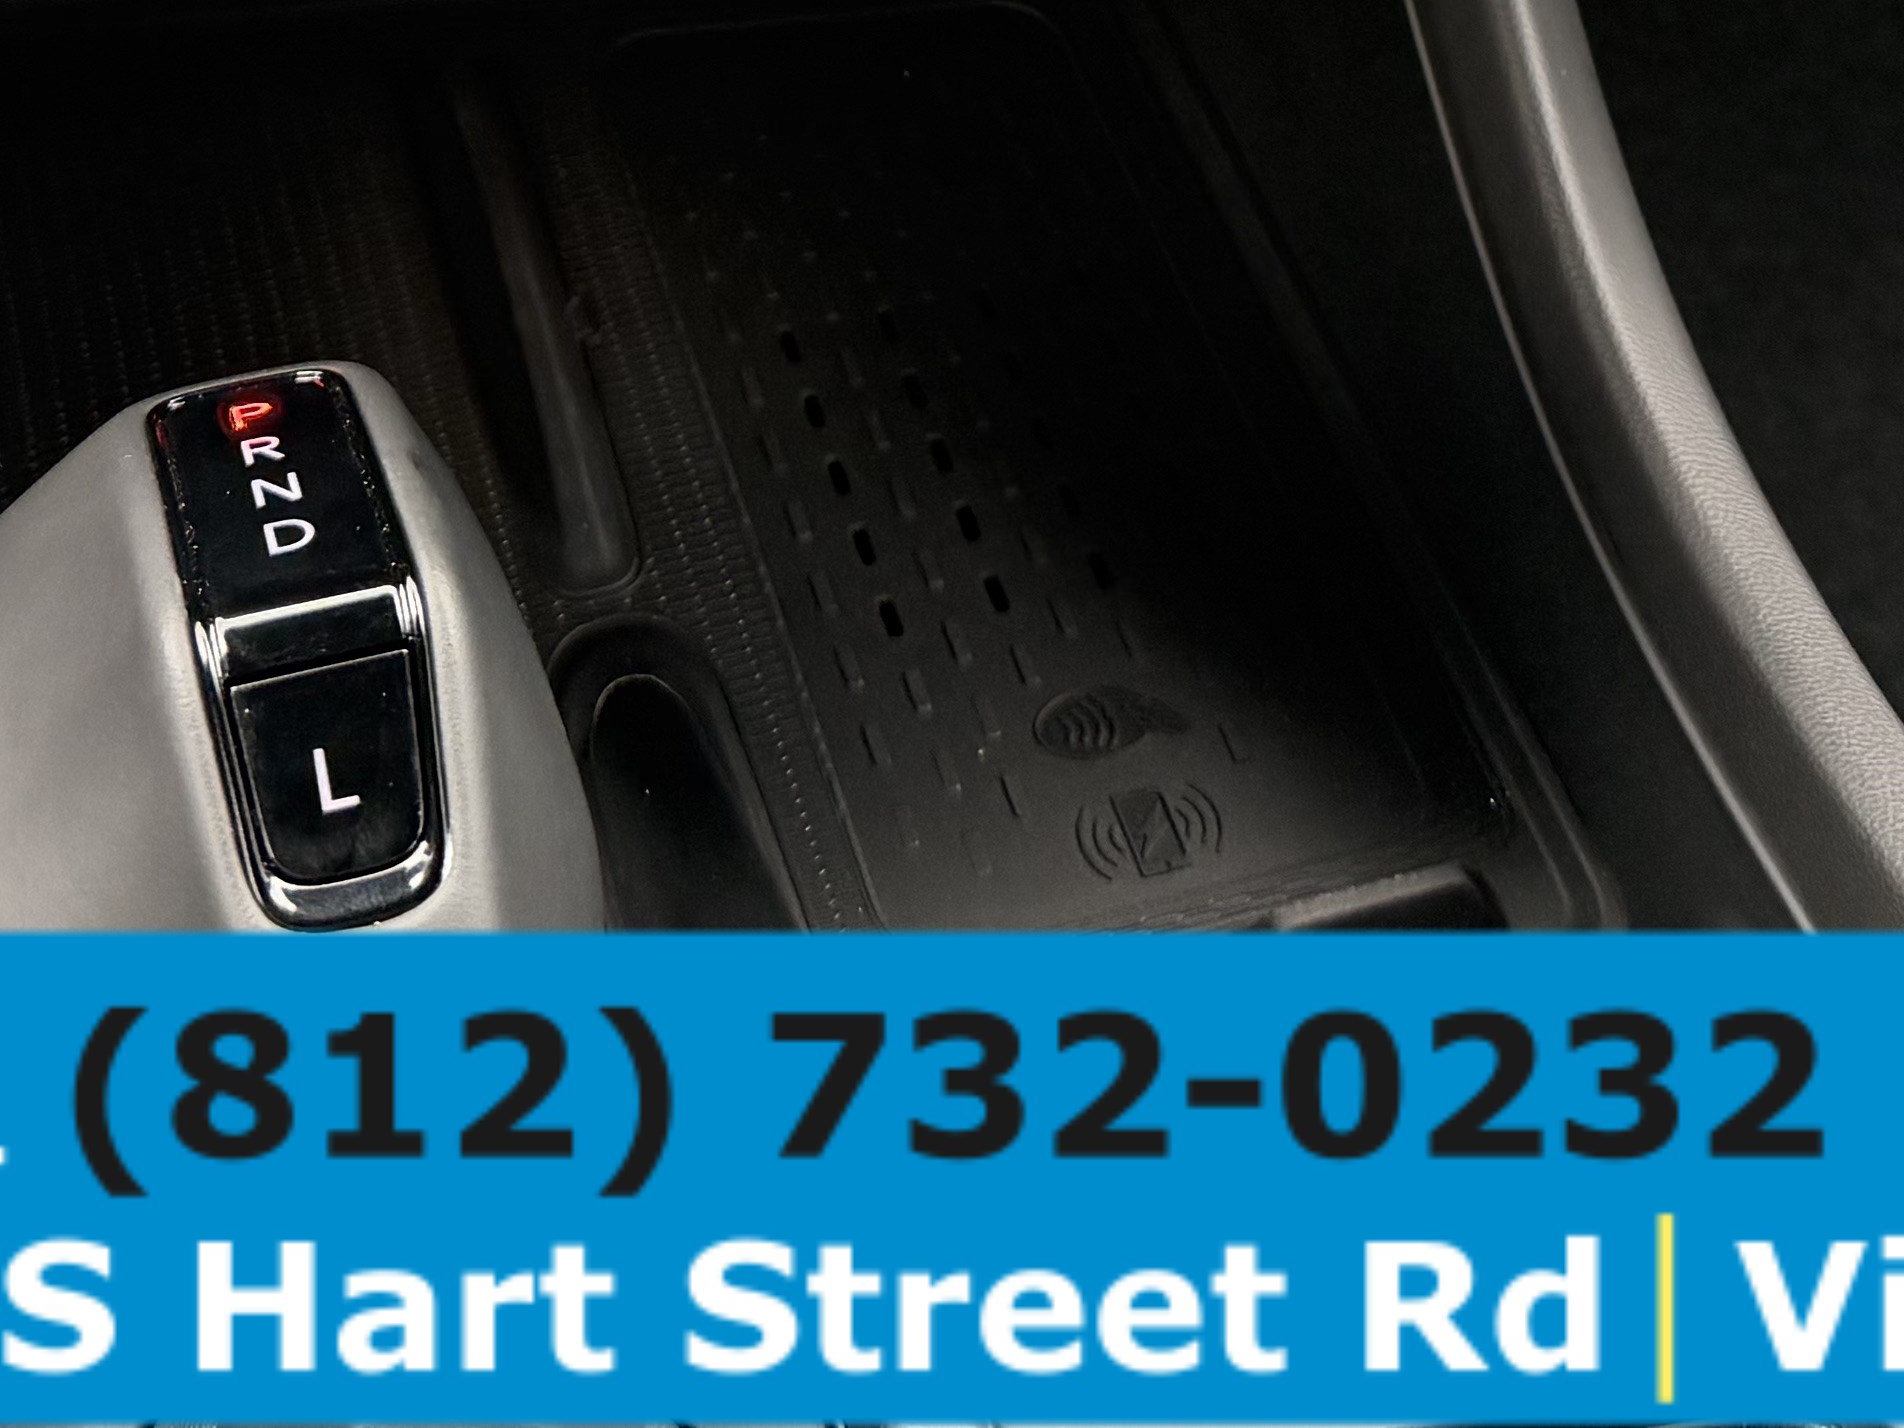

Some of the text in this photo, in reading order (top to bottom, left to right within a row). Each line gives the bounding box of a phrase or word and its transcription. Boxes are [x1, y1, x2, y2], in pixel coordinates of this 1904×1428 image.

[229, 403, 274, 430] P
[241, 436, 284, 466] R
[251, 472, 302, 509] N
[263, 519, 315, 556] D
[313, 748, 360, 814] L
